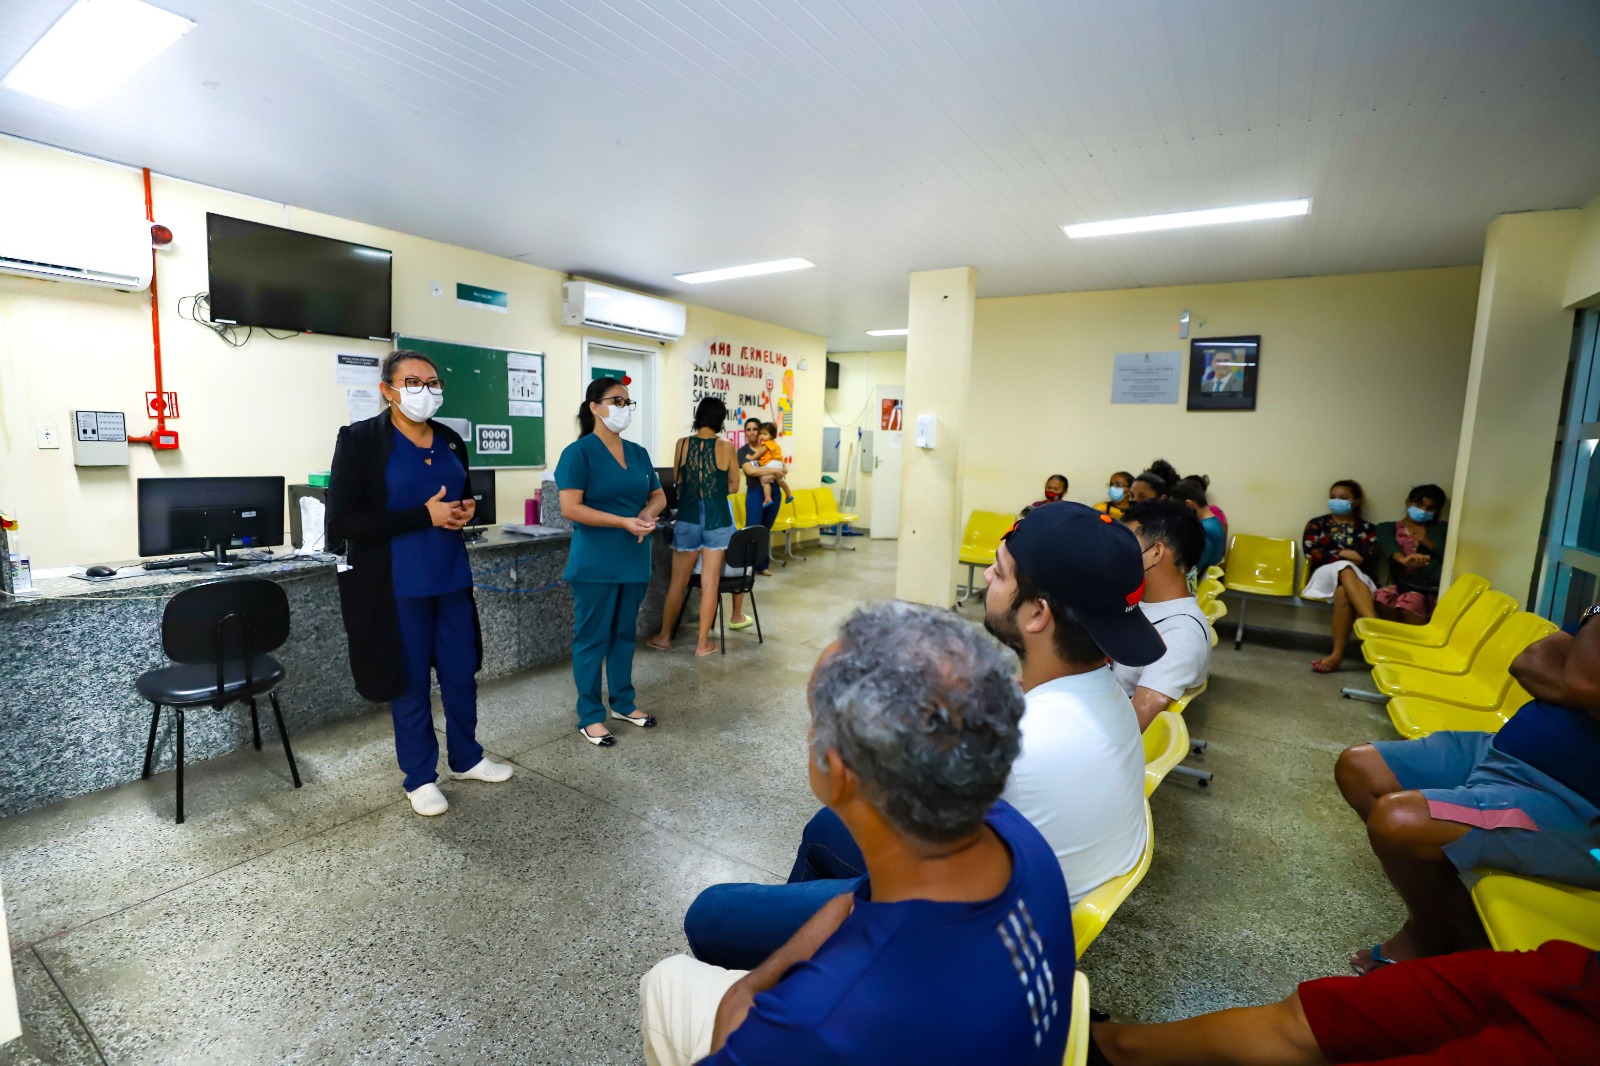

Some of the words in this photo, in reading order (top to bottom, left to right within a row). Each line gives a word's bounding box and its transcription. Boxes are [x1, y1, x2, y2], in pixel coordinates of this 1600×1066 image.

[721, 362, 763, 379] SOLIDÁRIO
[693, 374, 709, 388] DOE
[710, 377, 730, 391] VIDA
